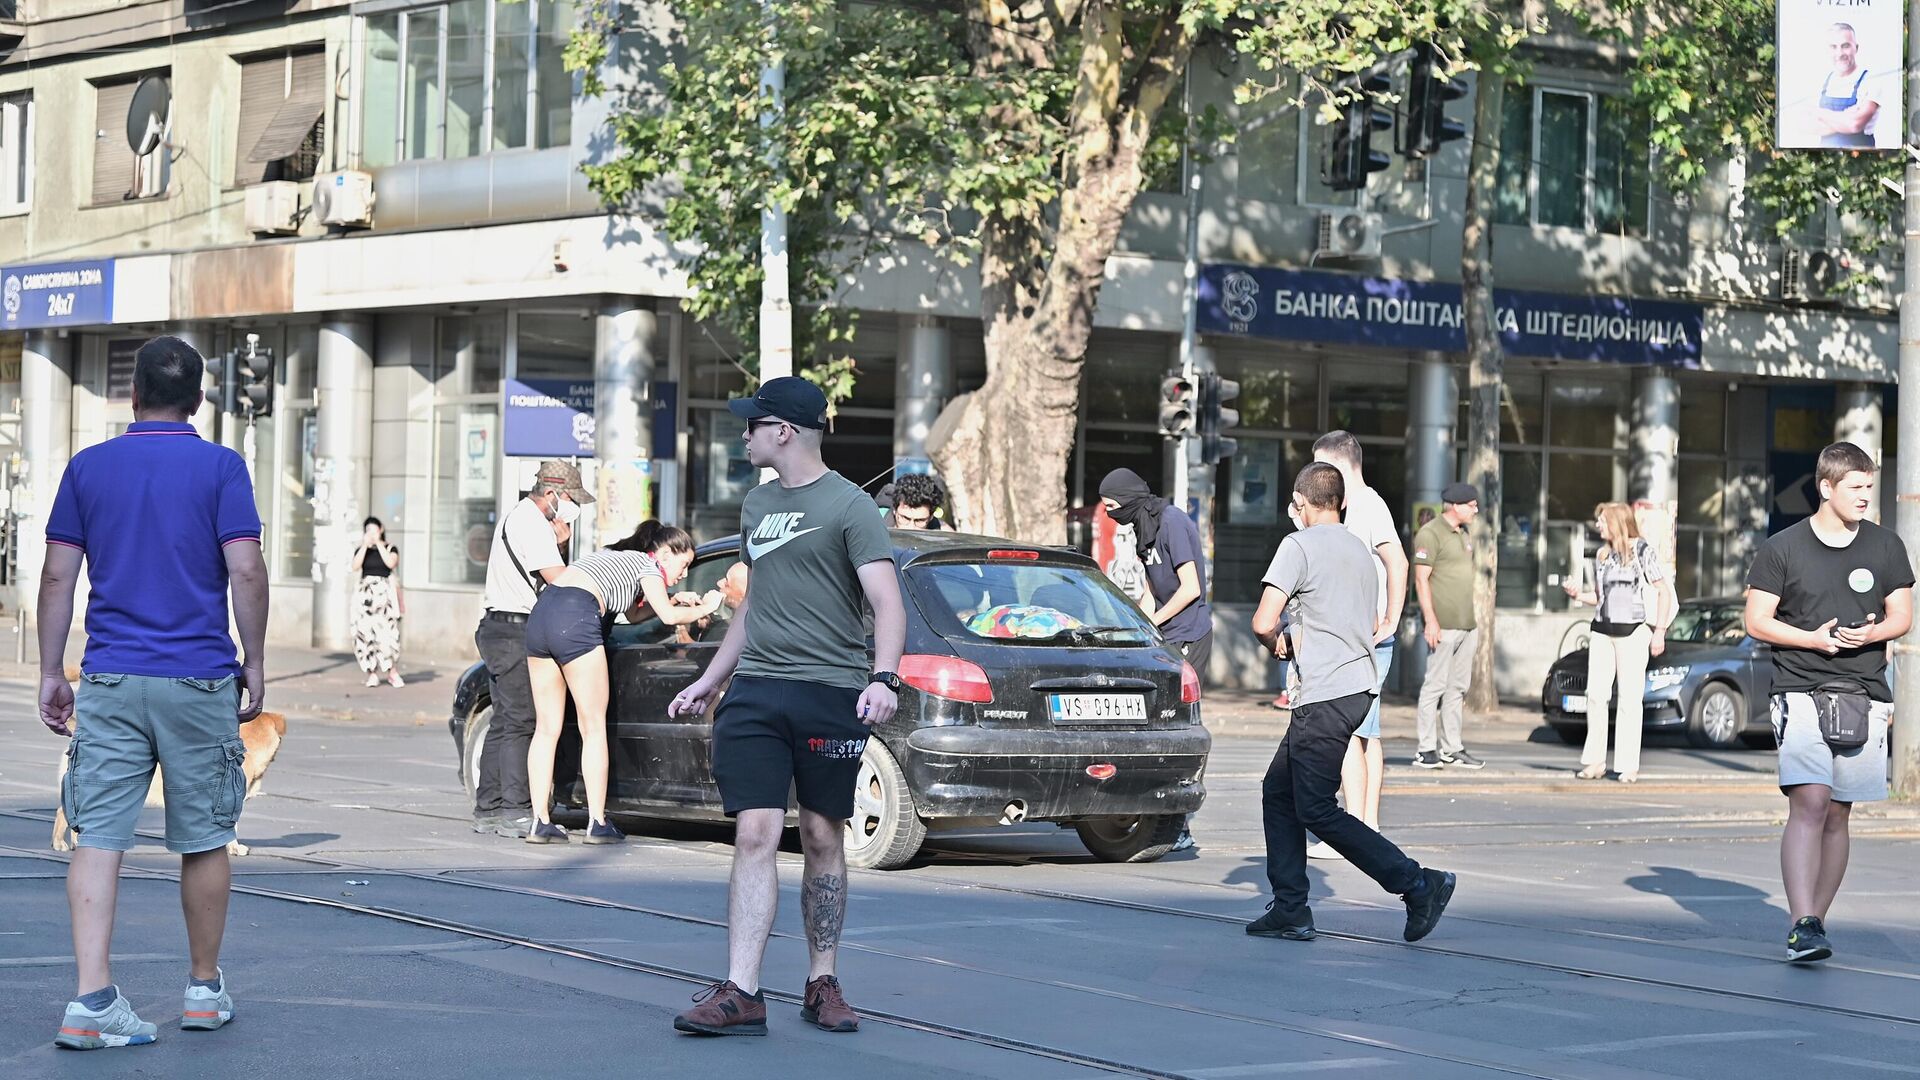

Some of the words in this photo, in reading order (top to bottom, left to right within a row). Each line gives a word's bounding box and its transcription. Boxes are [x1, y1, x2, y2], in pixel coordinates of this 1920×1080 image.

[1275, 290, 1360, 320] БАНКА
[1526, 310, 1687, 348] ШТЕДИОНИЦА
[753, 512, 805, 539] NIKE
[983, 710, 1029, 720] PEUGEOT
[1063, 698, 1083, 716] VS
